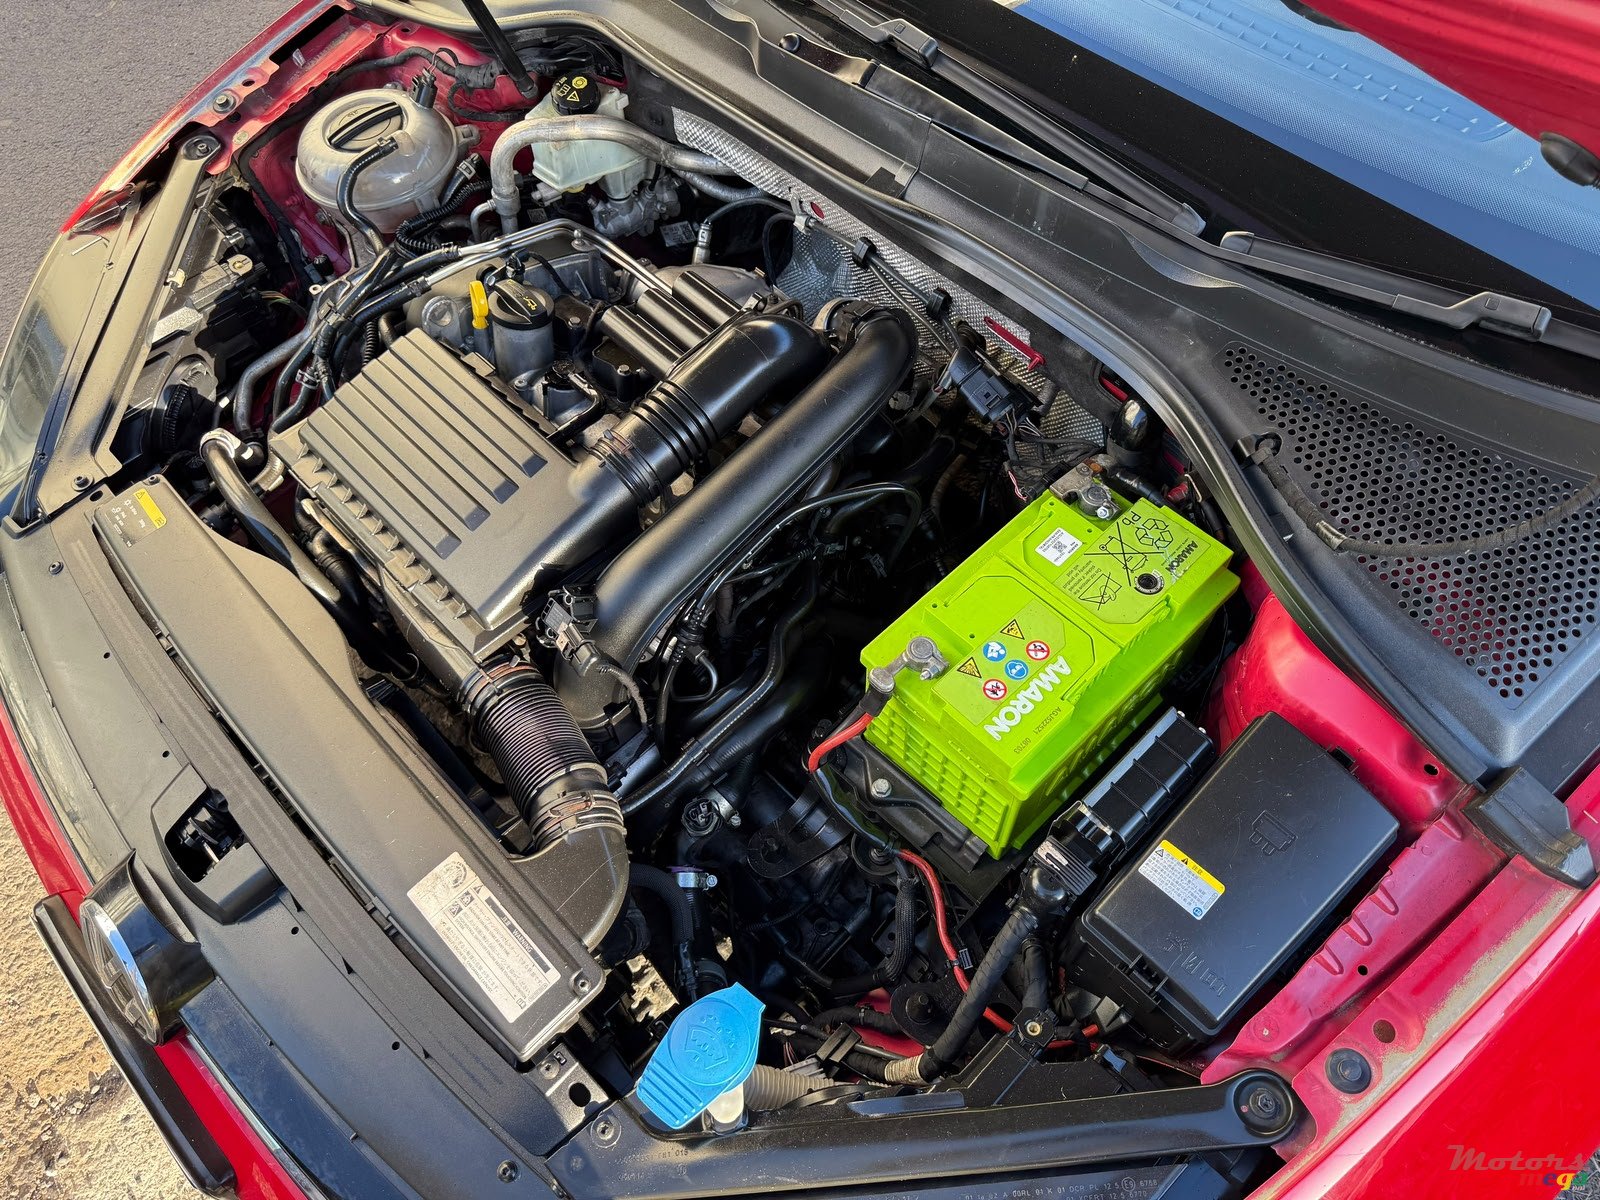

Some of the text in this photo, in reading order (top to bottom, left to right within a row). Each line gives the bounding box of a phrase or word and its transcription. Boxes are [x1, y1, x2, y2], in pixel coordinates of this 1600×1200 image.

[1122, 511, 1142, 527] Pb
[983, 655, 1072, 742] AMARON
[512, 928, 533, 953] WARNING
